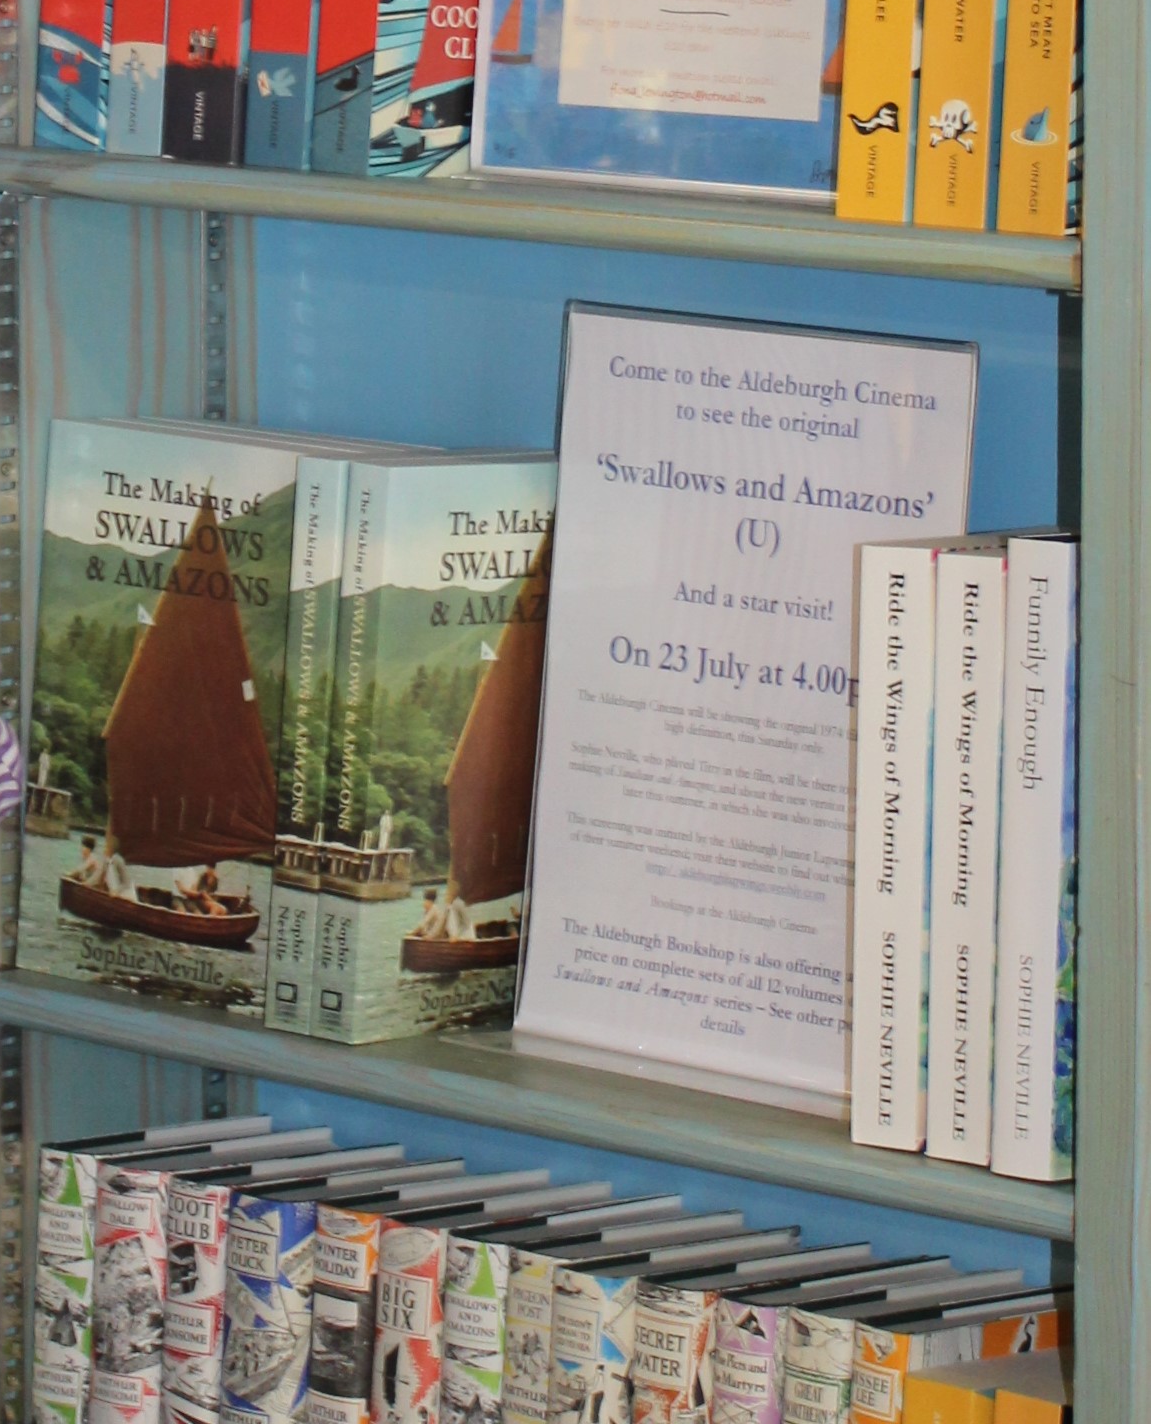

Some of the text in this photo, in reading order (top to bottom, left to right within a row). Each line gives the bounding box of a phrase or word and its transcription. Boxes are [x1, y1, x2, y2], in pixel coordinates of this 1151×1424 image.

[444, 37, 476, 59] CL
[1029, 20, 1040, 48] SEA
[1042, 17, 1054, 59] MEAN
[193, 90, 206, 141] VINTAGE
[865, 145, 877, 199] VINTAGE
[946, 153, 958, 208] VINTAGE
[1028, 161, 1040, 216] VINTAGE
[609, 355, 937, 411] Come to the Aldeburgh Cinema
[675, 402, 860, 442] to see the original
[103, 471, 262, 521] The Making of
[735, 474, 785, 502] and
[95, 510, 263, 562] SWALLOWS
[734, 517, 781, 558] (U)
[85, 556, 270, 607] & AMAZONS
[673, 581, 834, 621] And a star visit!
[609, 635, 650, 668] On
[658, 642, 688, 672] 23
[694, 647, 750, 690] July
[759, 664, 784, 687] at
[877, 572, 906, 1127] Ride the Wings of Morning SOPHIE NEVILLE
[1014, 575, 1049, 1141] Funnily Enough SOPHIE NEVILLE
[80, 936, 225, 986] Sophie Neville
[562, 917, 842, 984] The Aldeburgh Bookshop is also offering
[554, 963, 833, 1027] Swallows and Amazons series See other
[700, 1016, 746, 1036] details
[380, 1302, 414, 1332] SIX
[381, 1283, 417, 1309] BIG
